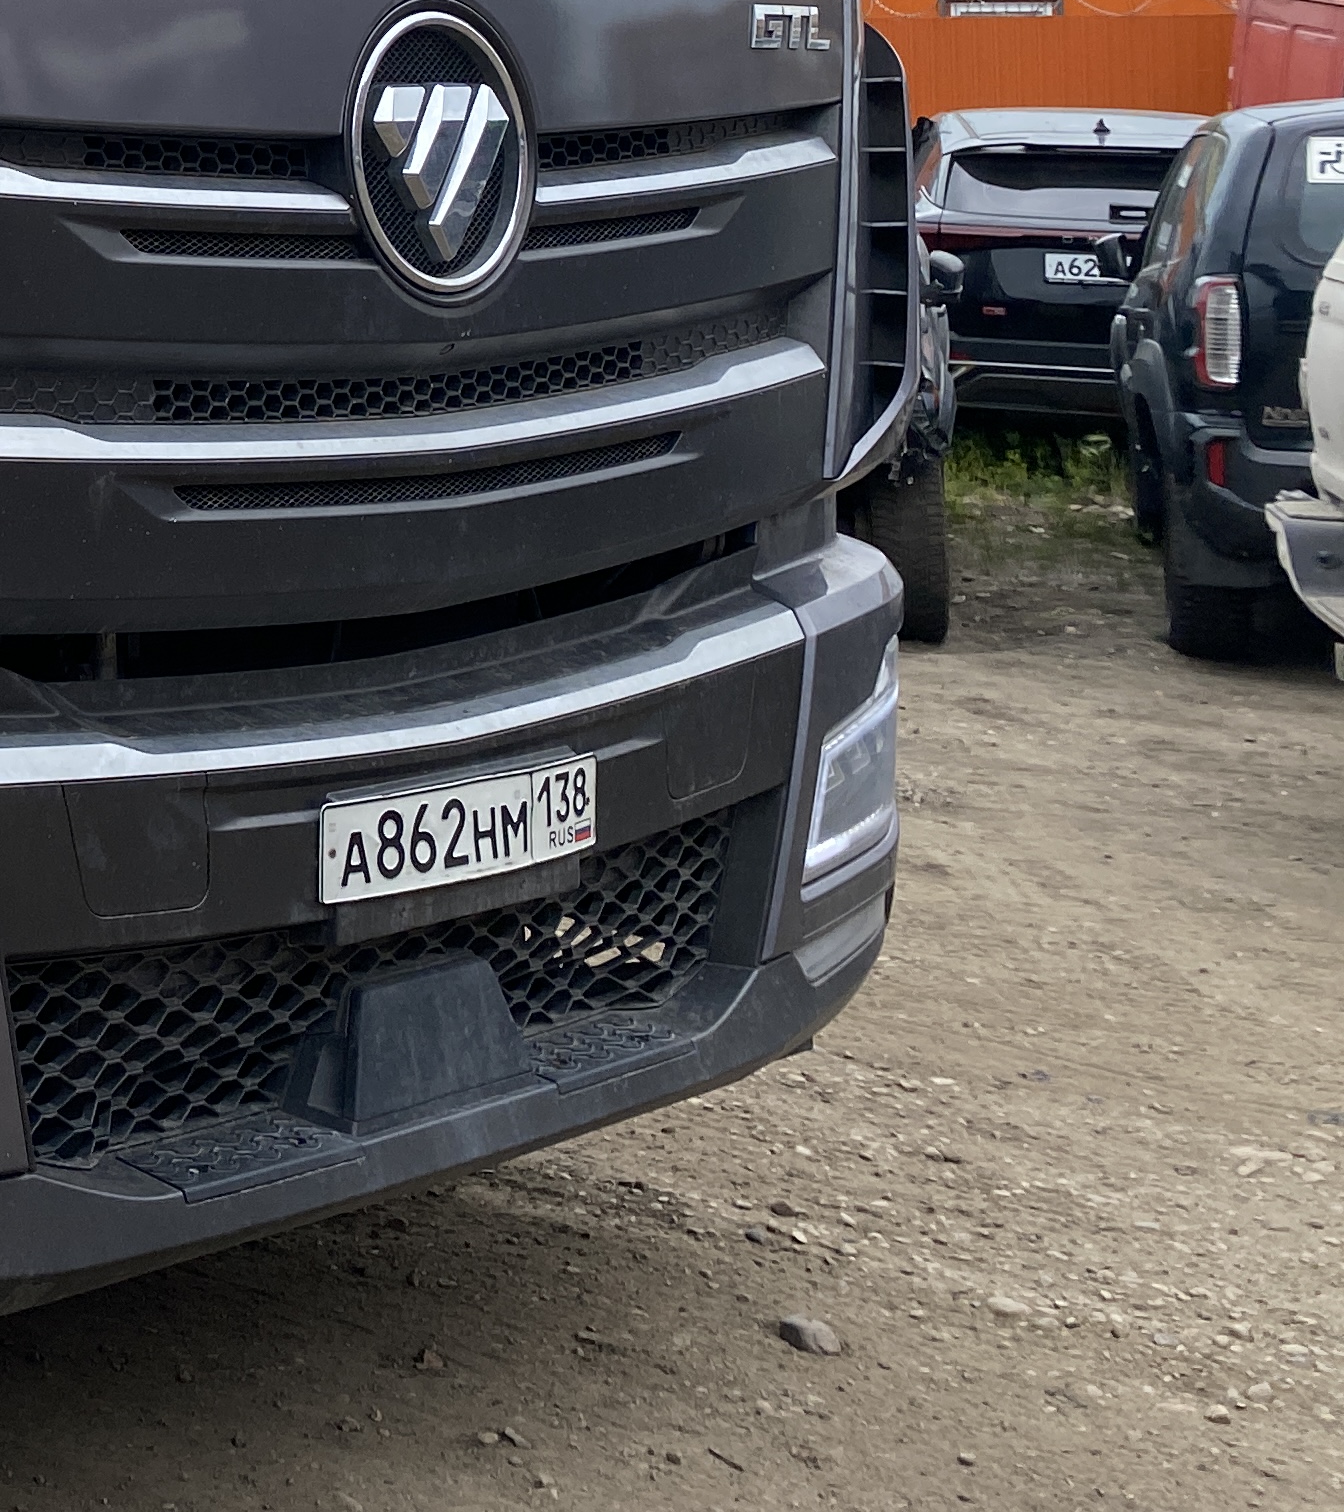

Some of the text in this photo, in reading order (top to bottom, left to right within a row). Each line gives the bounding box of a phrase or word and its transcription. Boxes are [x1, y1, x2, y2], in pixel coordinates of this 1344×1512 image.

[750, 3, 831, 50] GTL
[1054, 257, 1100, 277] А62
[341, 767, 588, 888] А862НМ 138
[549, 827, 575, 849] RUS
